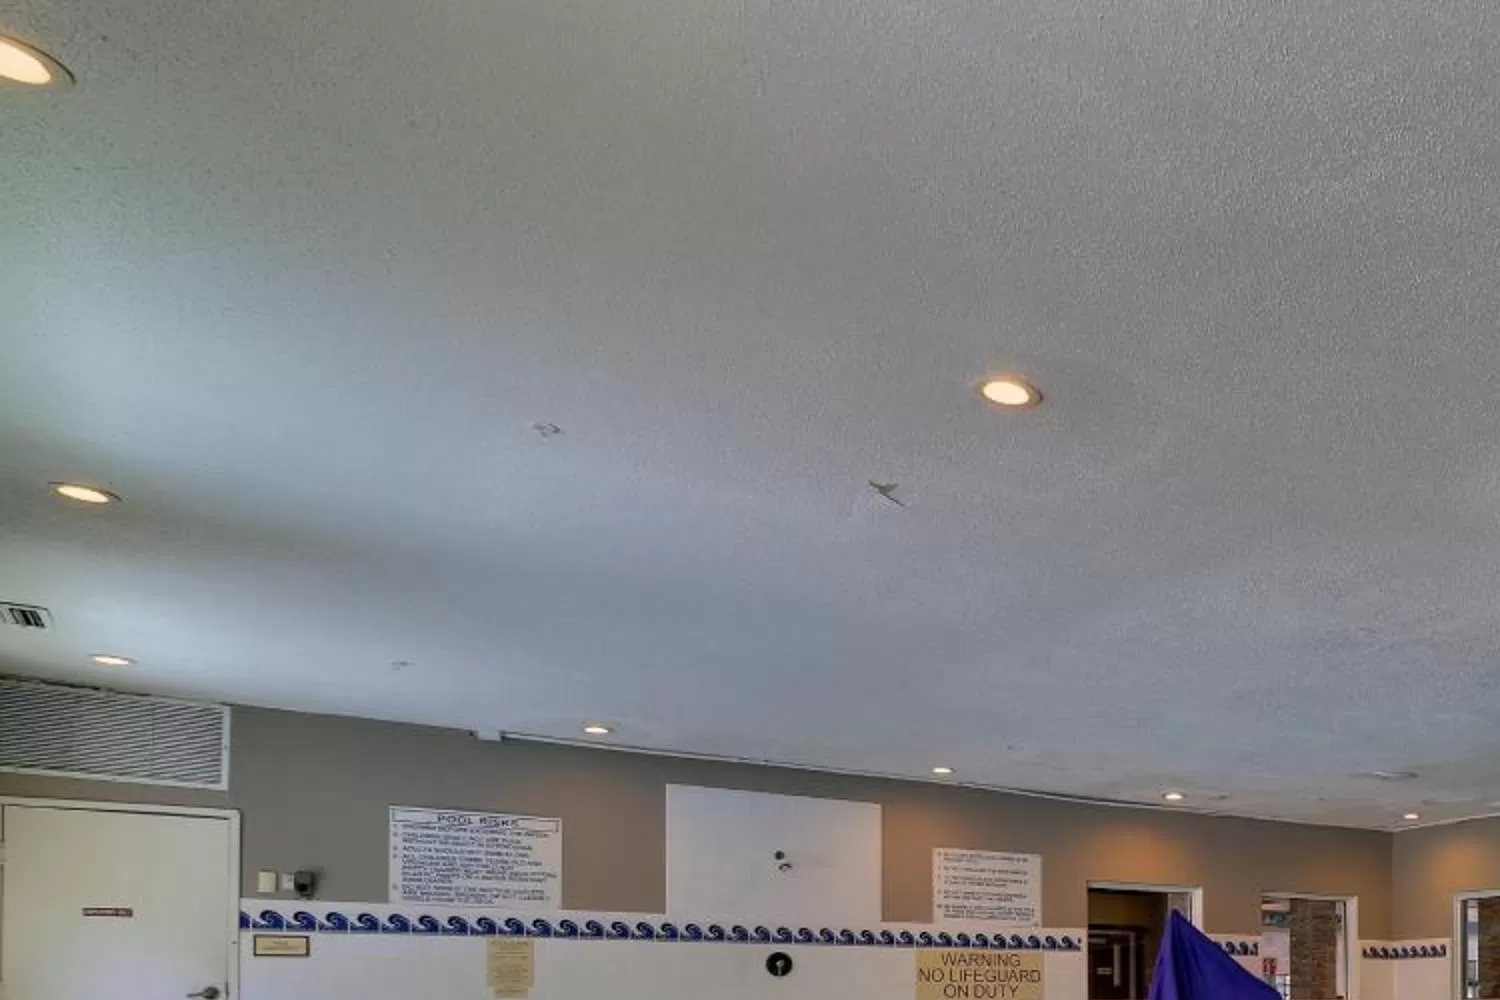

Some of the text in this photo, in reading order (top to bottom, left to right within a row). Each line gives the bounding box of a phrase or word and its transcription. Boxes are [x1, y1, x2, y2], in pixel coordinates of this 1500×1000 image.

[437, 815, 473, 825] POOL
[942, 953, 1021, 967] WARNING
[918, 967, 1041, 983] NO LIFEGUARD
[943, 983, 1020, 999] ON DUTY
